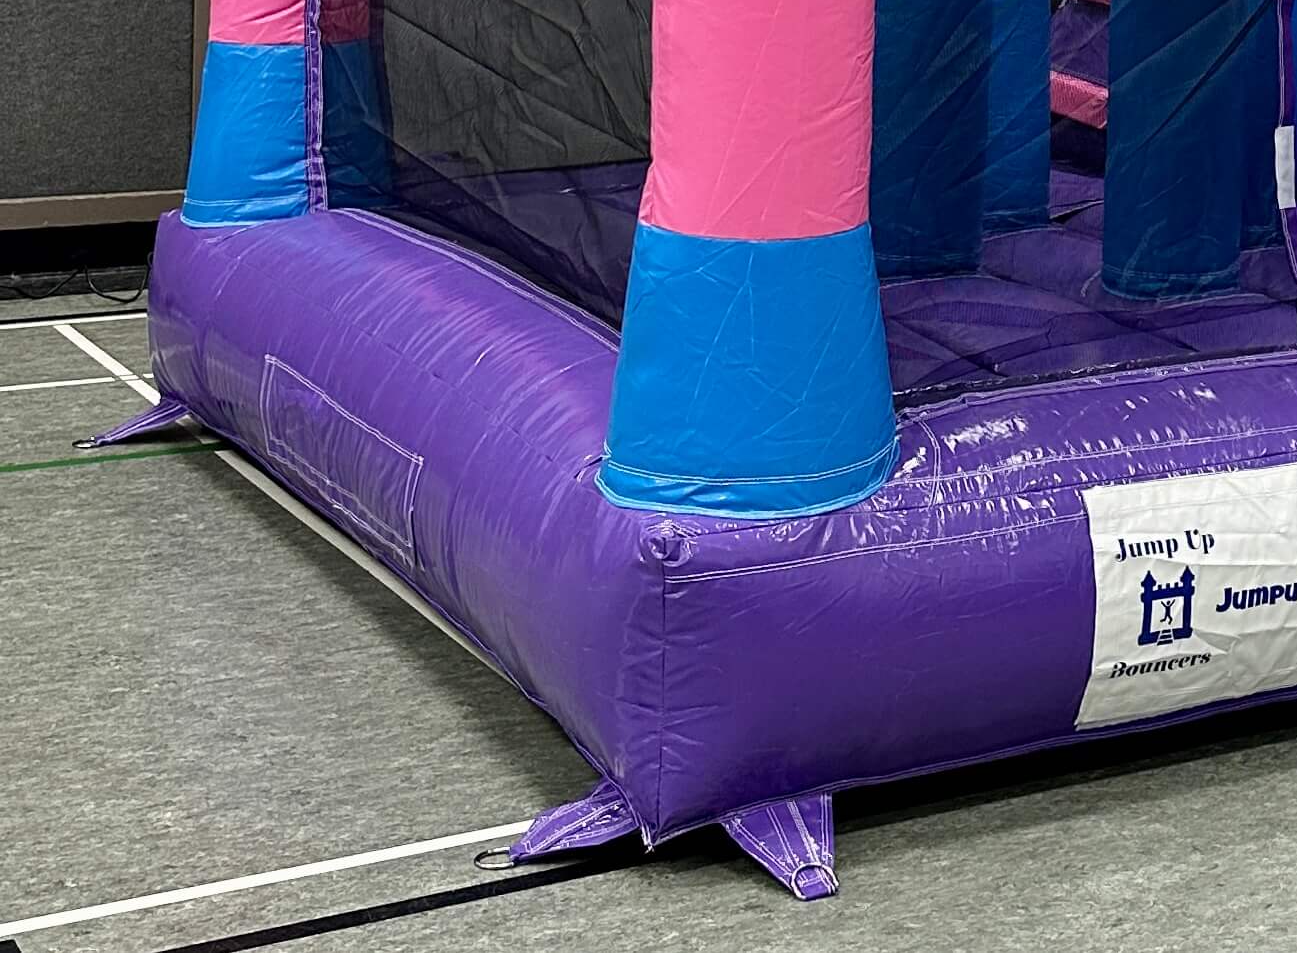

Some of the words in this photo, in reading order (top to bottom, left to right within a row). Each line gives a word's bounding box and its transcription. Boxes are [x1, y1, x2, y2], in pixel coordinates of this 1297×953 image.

[1115, 537, 1178, 562] Jump
[1185, 529, 1215, 553] Up
[1110, 652, 1211, 678] Bouncers
